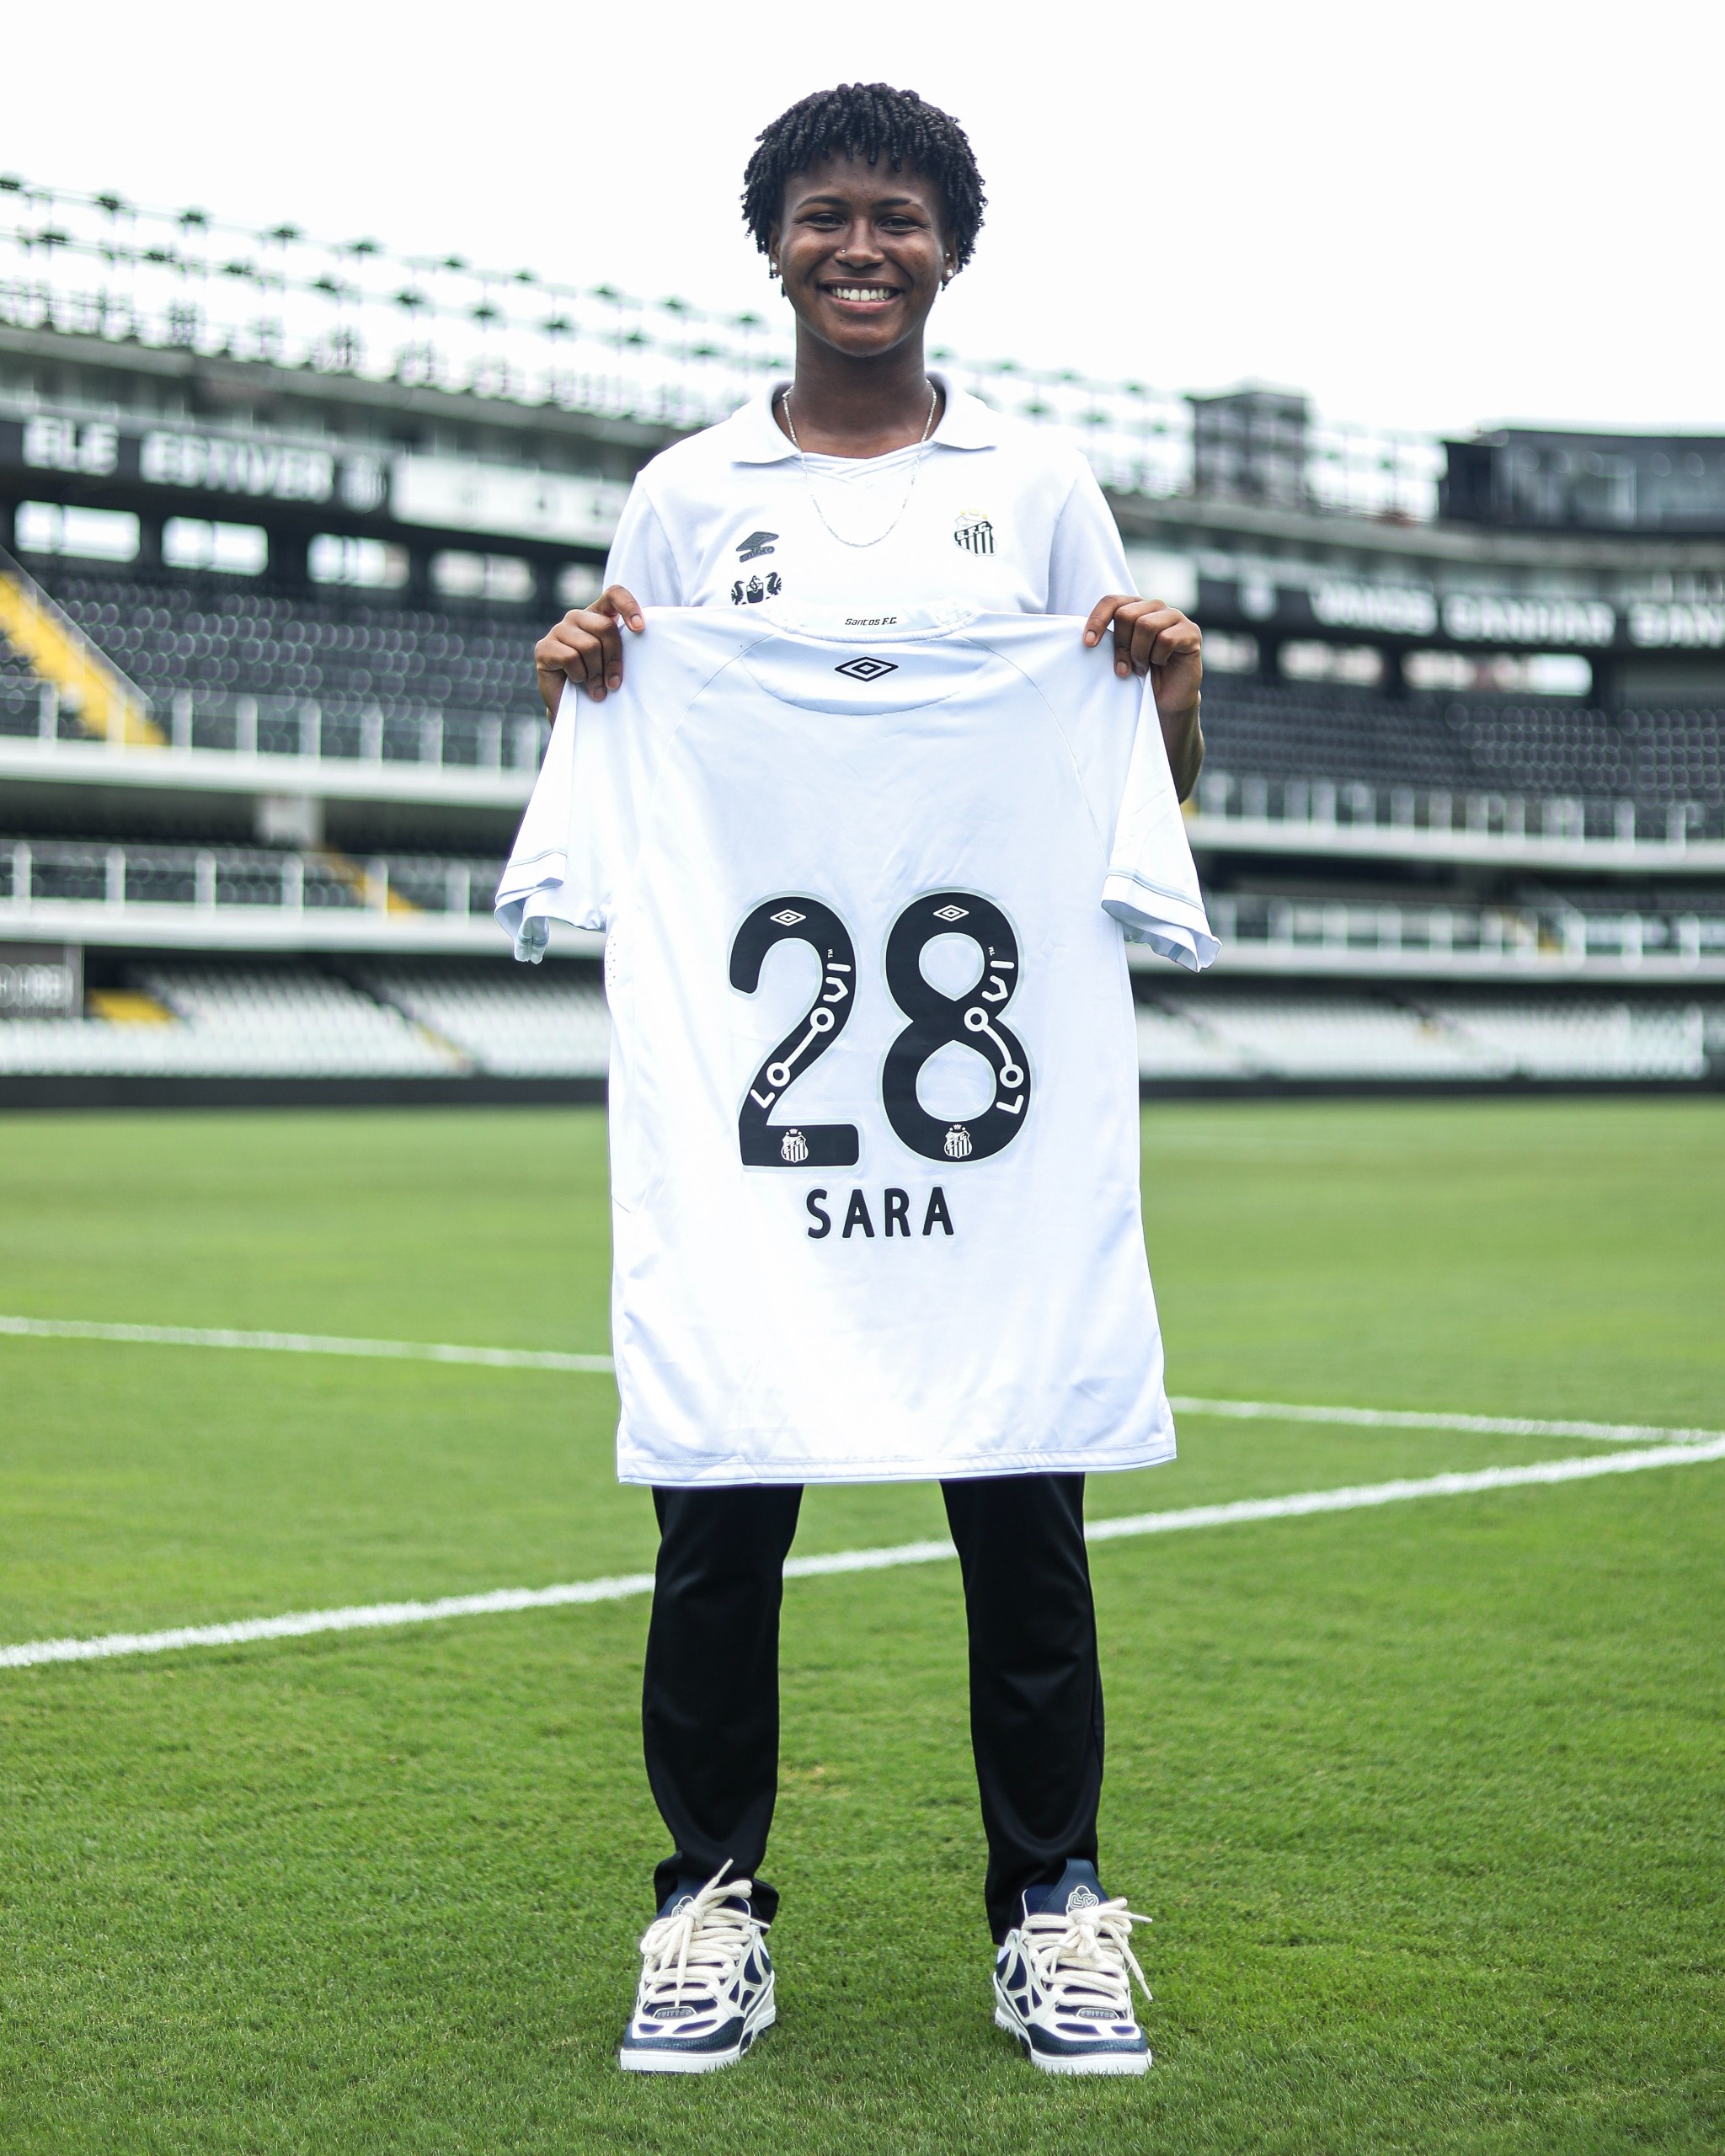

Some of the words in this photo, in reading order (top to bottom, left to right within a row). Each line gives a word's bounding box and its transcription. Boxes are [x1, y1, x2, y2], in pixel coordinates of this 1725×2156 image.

[24, 416, 119, 477] ELE
[140, 430, 334, 504] ESTIVER
[729, 893, 1030, 1166] 28
[807, 1187, 953, 1239] SARA
